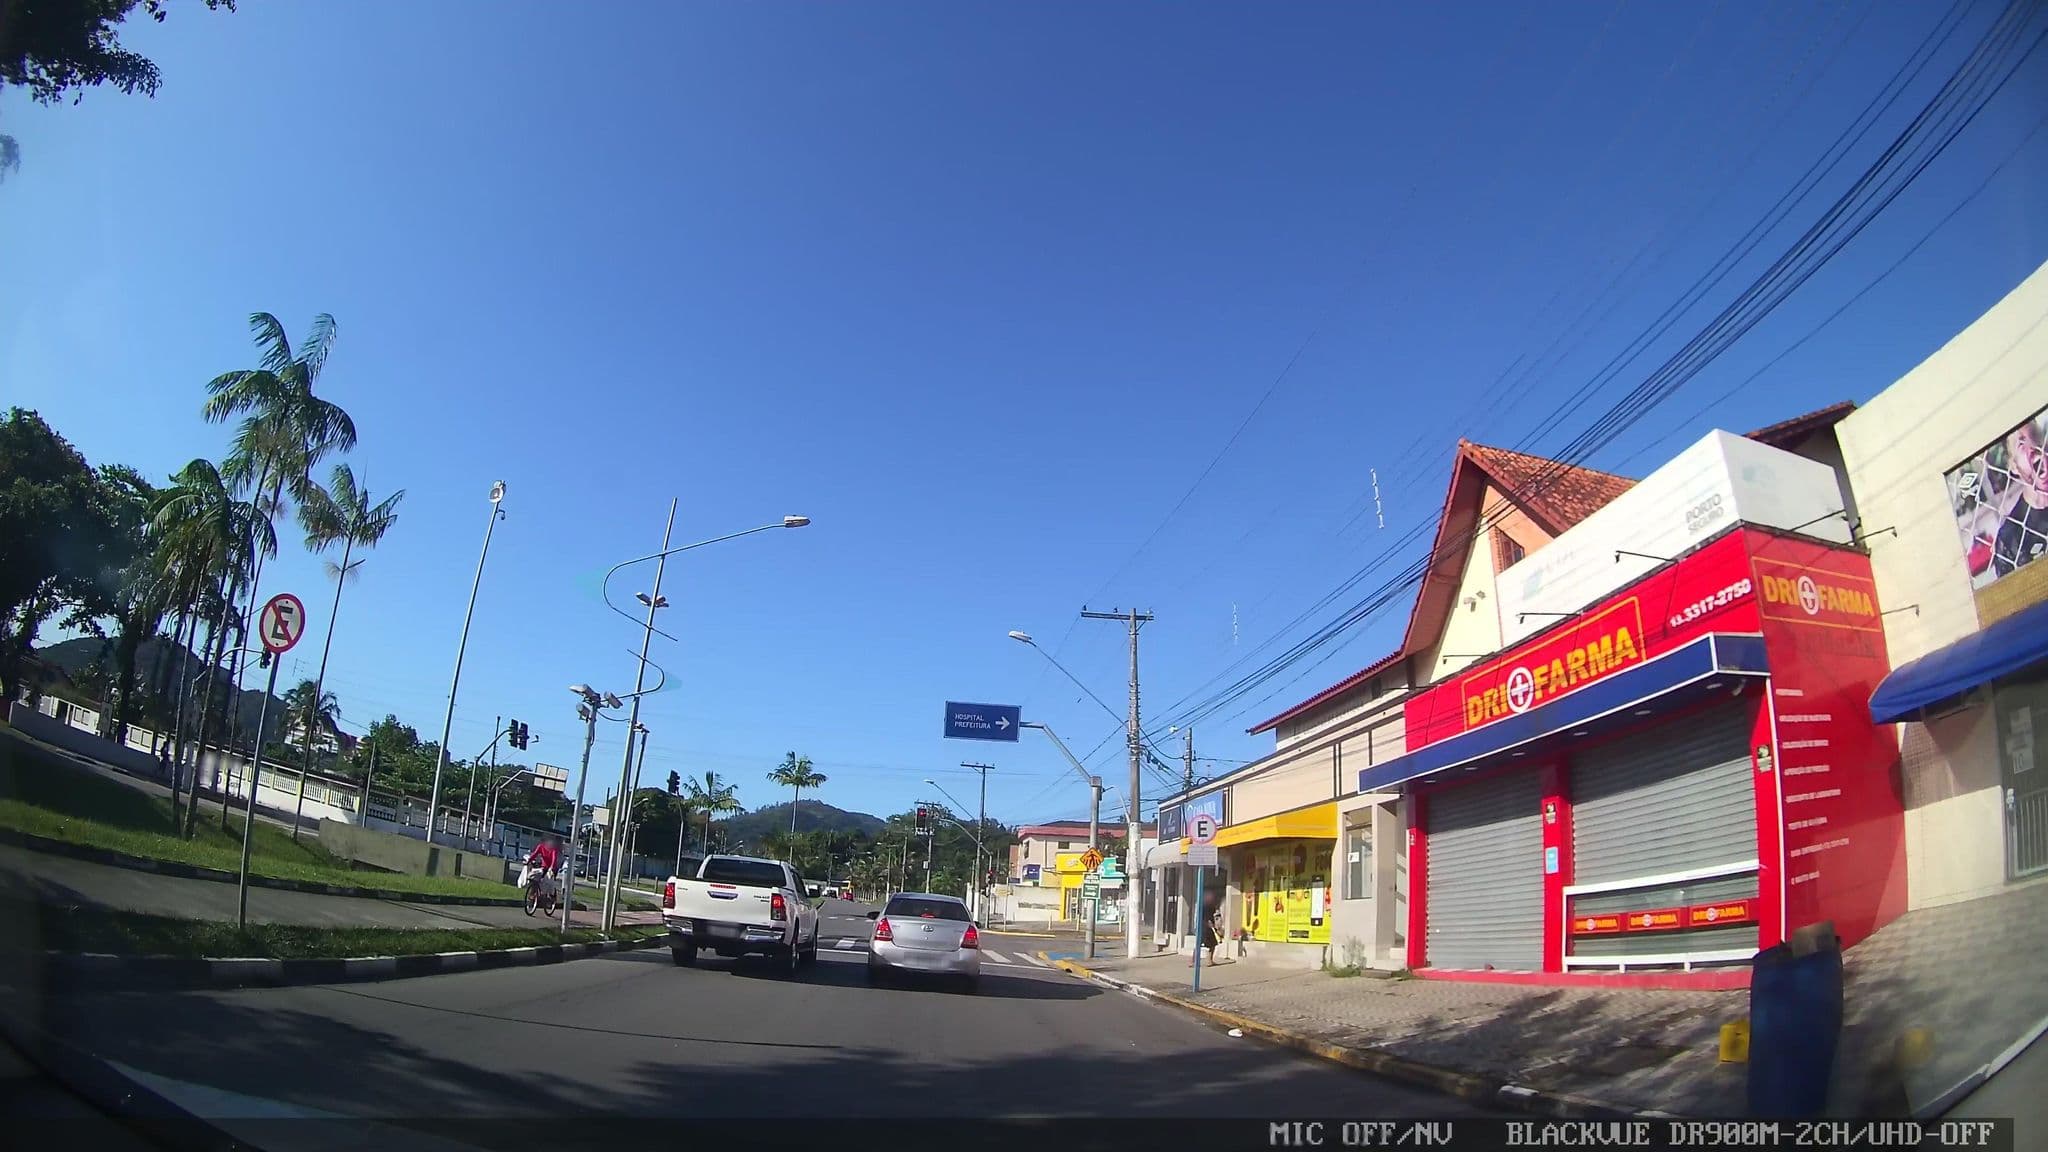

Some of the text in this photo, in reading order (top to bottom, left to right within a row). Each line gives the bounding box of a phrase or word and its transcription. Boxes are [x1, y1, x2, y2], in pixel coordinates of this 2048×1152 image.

[954, 713, 984, 721] HOSPITAL
[954, 721, 991, 729] PREFEITURA
[1197, 820, 1208, 838] E
